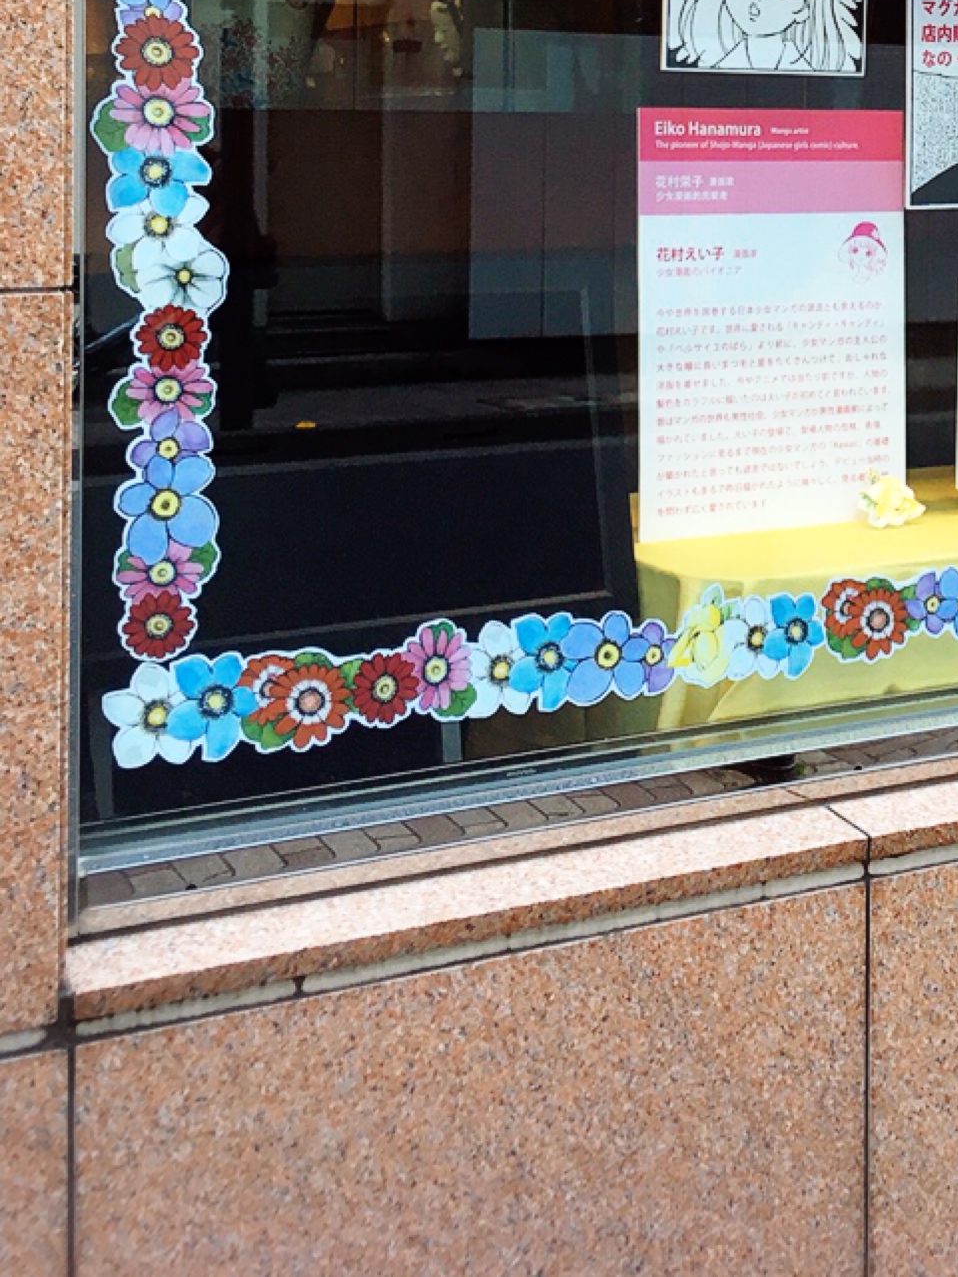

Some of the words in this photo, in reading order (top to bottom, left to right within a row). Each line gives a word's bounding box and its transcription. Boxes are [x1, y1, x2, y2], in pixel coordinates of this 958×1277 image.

[654, 120, 685, 136] Eiko
[688, 121, 762, 136] Hanamura
[656, 246, 724, 262] 花村えい子
